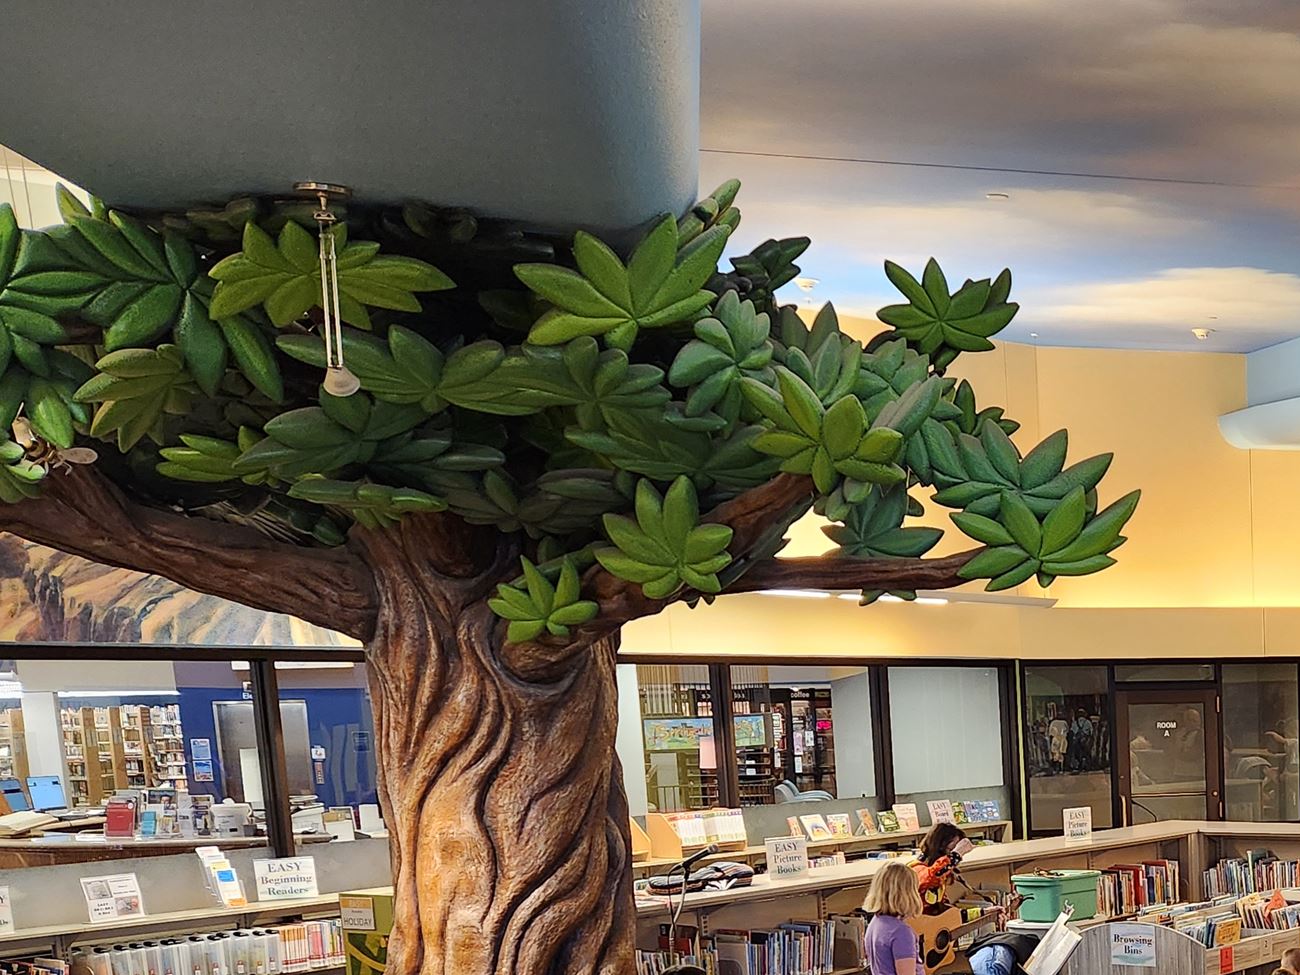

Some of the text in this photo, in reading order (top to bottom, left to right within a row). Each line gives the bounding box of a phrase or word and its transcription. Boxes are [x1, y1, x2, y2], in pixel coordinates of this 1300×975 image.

[1156, 721, 1177, 729] ROOM
[775, 842, 798, 853] EASY
[773, 854, 802, 864] Picture
[268, 862, 302, 873] EASY
[777, 864, 802, 875] Books
[261, 875, 313, 886] Beginning
[267, 886, 309, 896] Readers
[343, 916, 372, 926] HOLIDAY
[1113, 933, 1153, 947] Browsing
[1124, 945, 1143, 955] Bins
